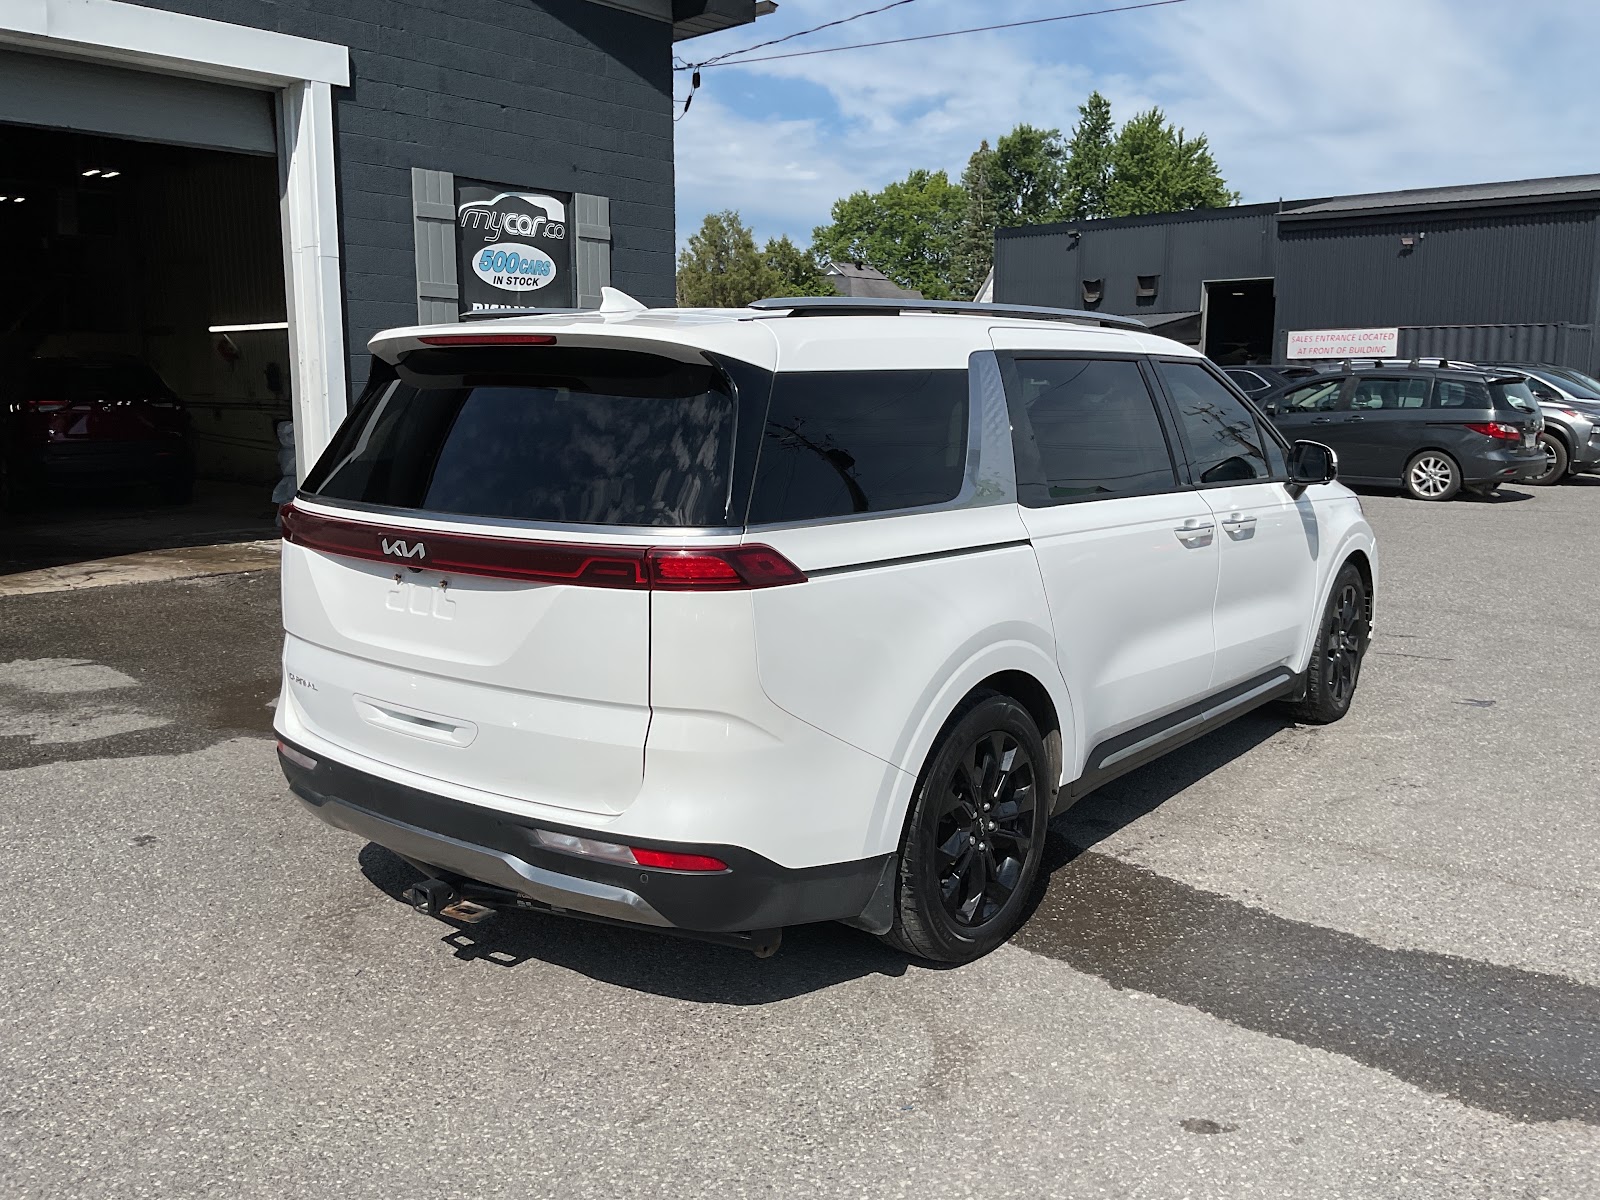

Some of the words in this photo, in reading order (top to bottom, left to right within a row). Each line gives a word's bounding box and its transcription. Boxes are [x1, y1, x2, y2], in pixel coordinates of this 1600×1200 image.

[479, 250, 520, 274] 500
[519, 259, 551, 276] CARS
[493, 276, 503, 285] IN
[506, 277, 540, 287] STOCK
[1292, 335, 1313, 343] SALES
[1315, 334, 1356, 342] ENTRANCE
[1358, 333, 1394, 341] LOCATED
[1349, 346, 1386, 354] BUILDING
[381, 538, 426, 559] KIA
